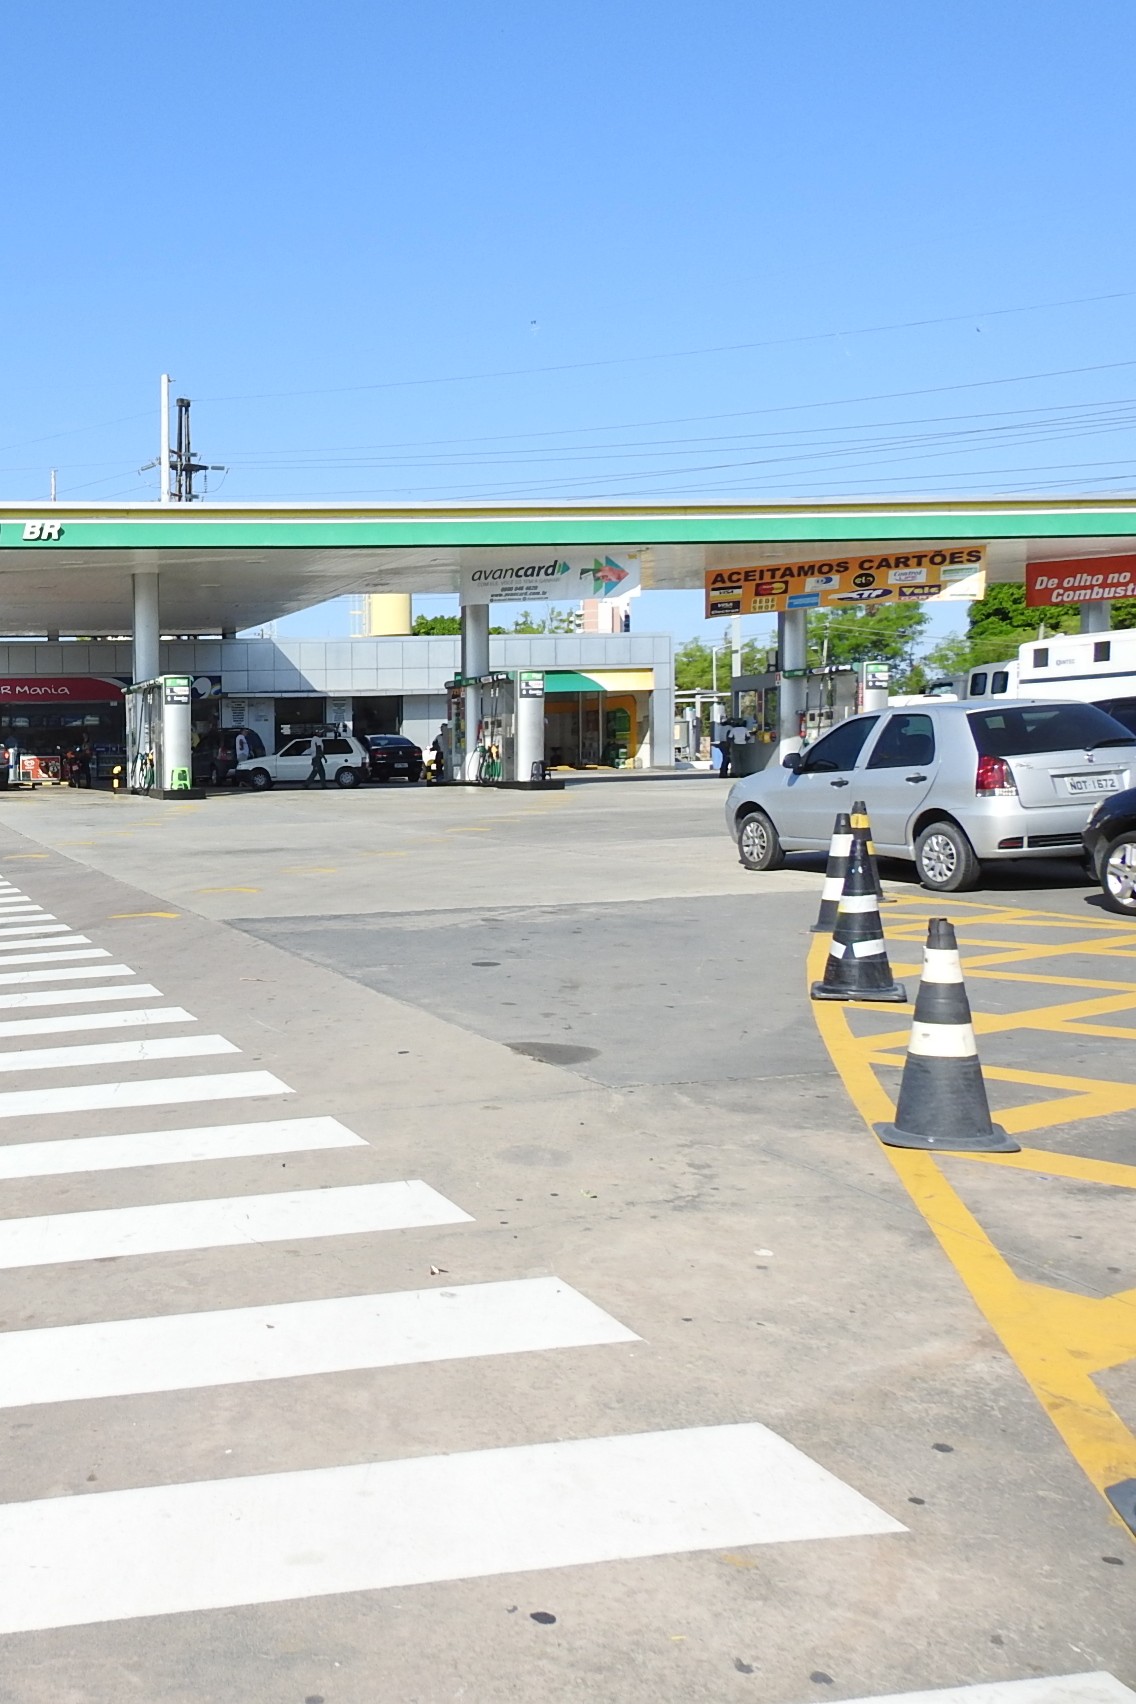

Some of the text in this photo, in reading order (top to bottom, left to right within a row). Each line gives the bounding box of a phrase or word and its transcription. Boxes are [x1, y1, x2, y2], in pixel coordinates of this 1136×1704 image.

[22, 521, 62, 541] BR
[471, 559, 558, 581] avancard
[711, 550, 982, 585] ACEITAMOS CARTÕES
[1035, 572, 1131, 590] De olho no
[15, 684, 70, 695] Mania
